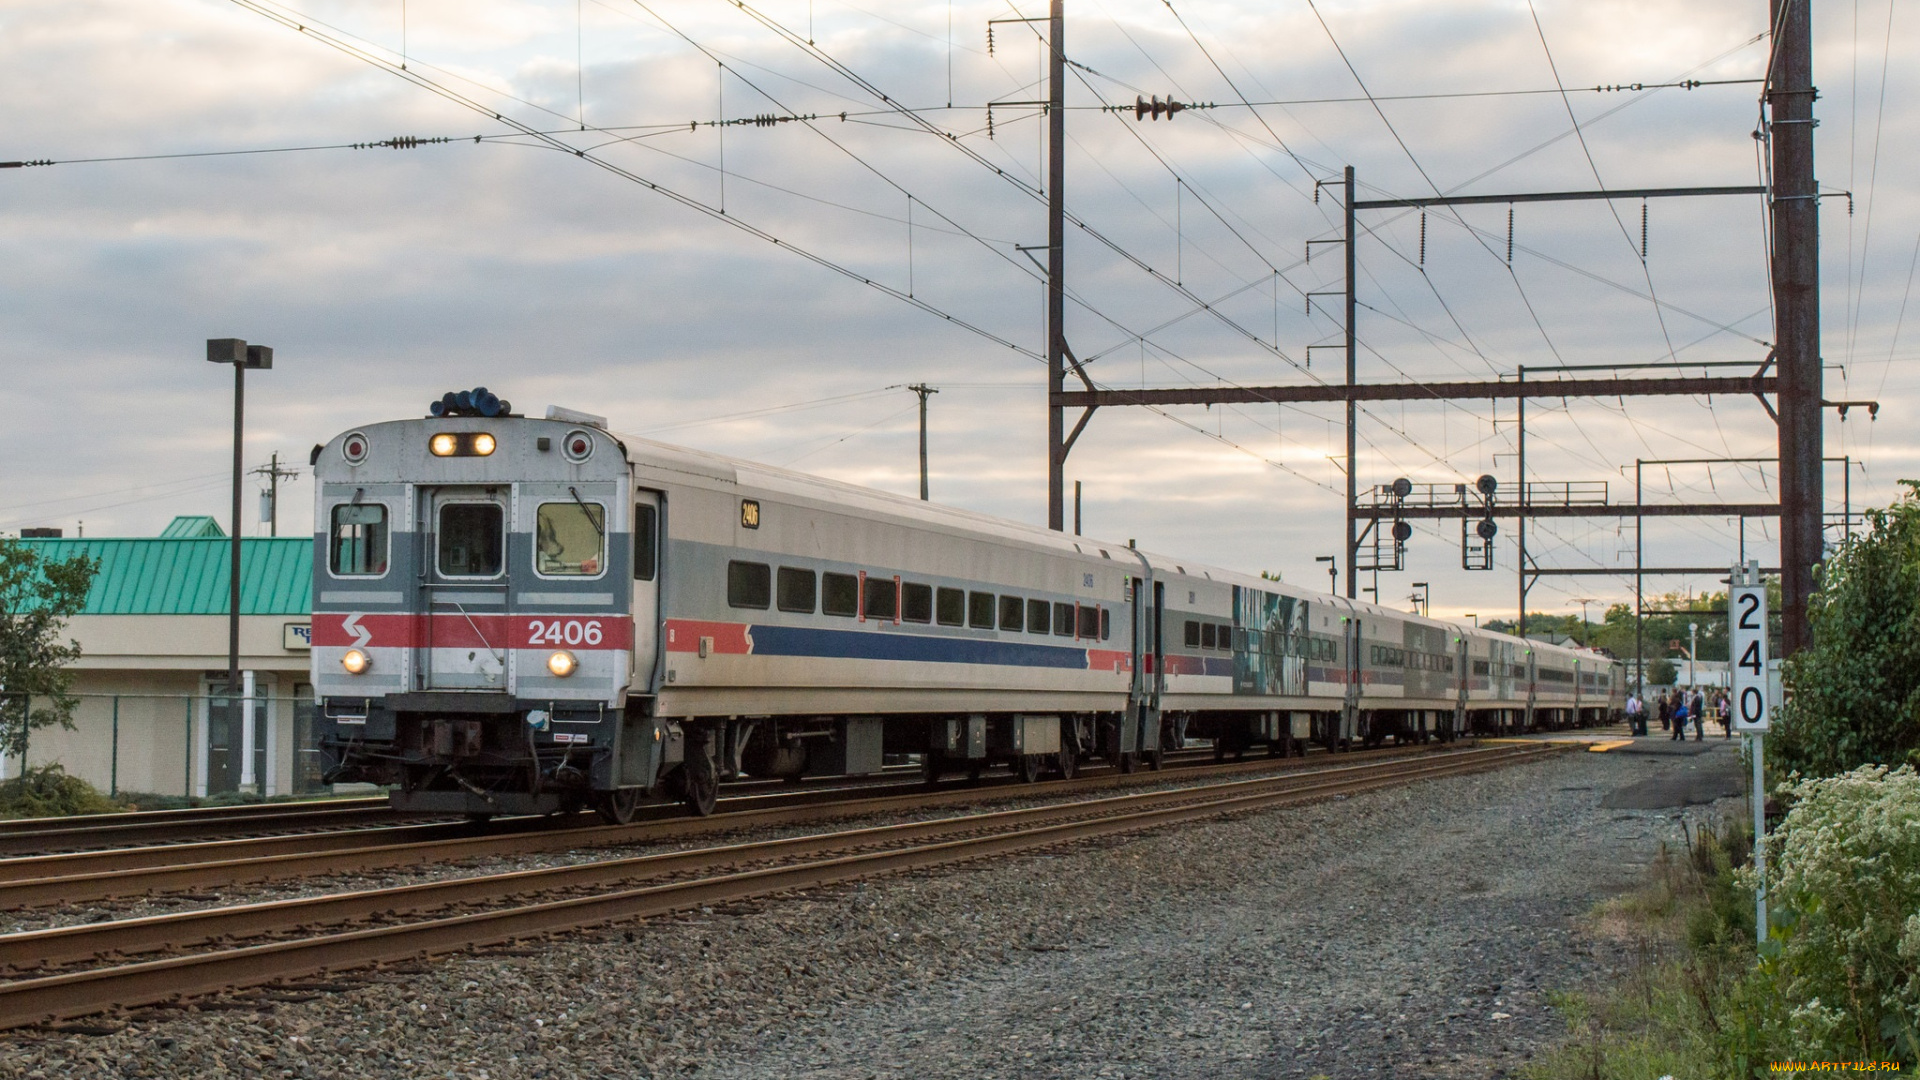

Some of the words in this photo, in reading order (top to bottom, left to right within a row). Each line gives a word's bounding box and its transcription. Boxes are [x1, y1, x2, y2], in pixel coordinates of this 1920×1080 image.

[743, 503, 758, 525] 2406
[528, 620, 603, 645] 2406
[1738, 593, 1763, 723] 240
